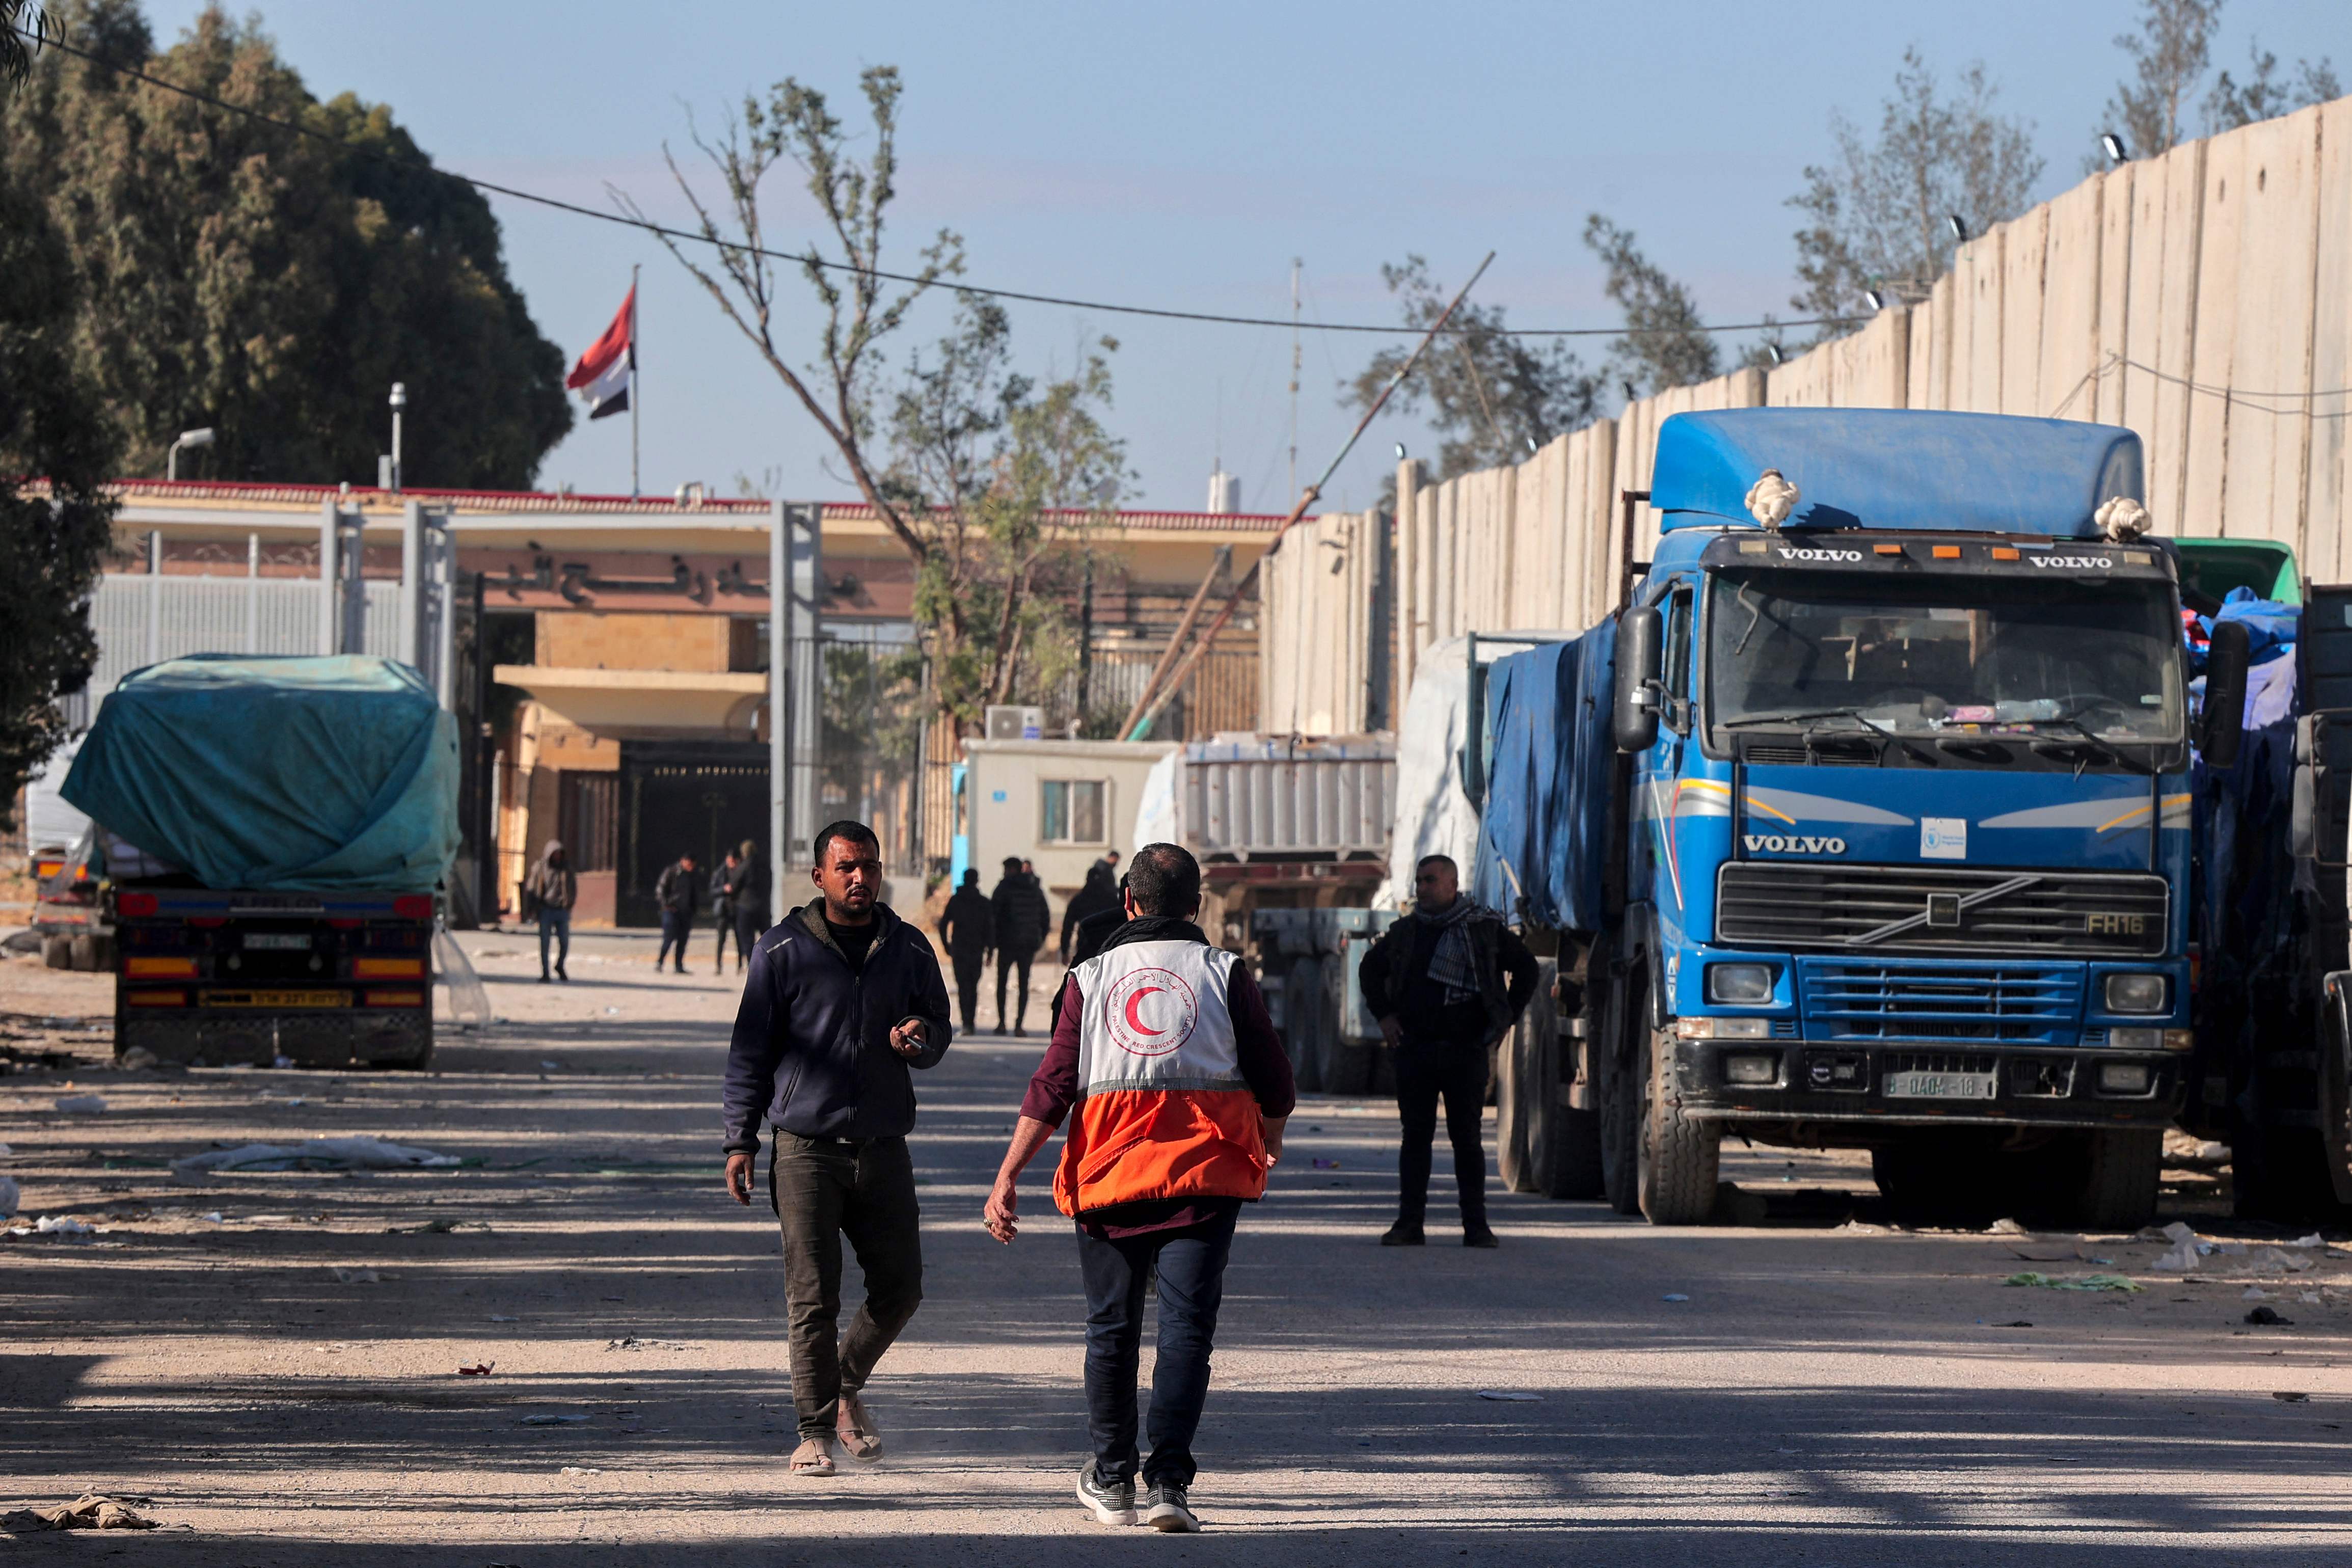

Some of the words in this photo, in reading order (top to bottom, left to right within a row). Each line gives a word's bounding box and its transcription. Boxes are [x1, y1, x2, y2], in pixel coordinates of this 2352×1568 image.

[1777, 548, 1862, 561] VOLVO
[2029, 556, 2113, 569] VOLVO
[1743, 835, 1846, 854] VOLVO
[2089, 914, 2144, 934] FH16
[1159, 975, 1182, 991] الهلال
[1179, 990, 1192, 1011] جمعية
[1112, 1015, 1131, 1043] PALESTINE
[1131, 1041, 1145, 1049] RED
[1146, 1036, 1177, 1049] CRESCENT
[1177, 1014, 1192, 1038] SOCIETY
